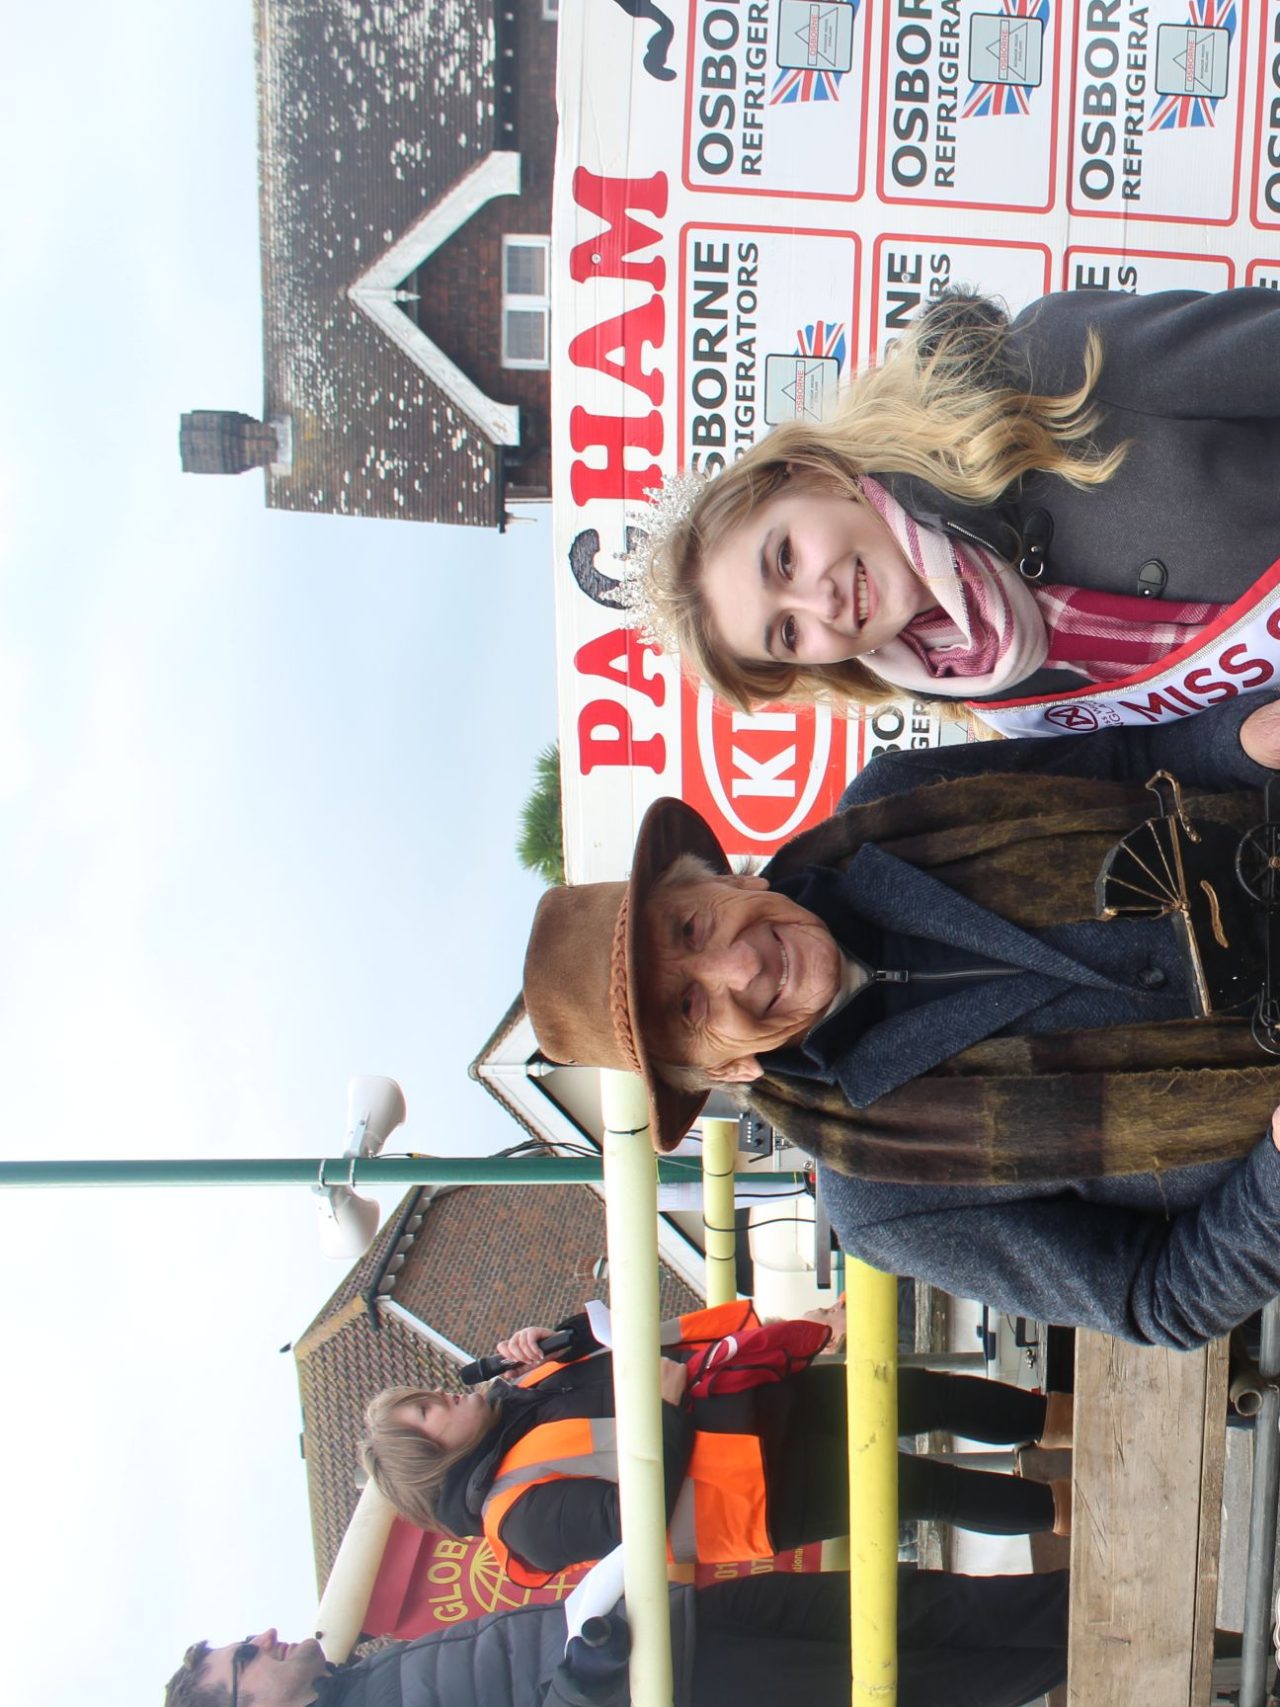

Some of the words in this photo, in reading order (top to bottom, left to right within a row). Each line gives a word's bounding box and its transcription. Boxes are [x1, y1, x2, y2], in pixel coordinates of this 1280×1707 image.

[809, 13, 818, 56] OSBORNE
[1000, 29, 1008, 70] OSBORNE
[1186, 39, 1195, 82] OSBORNE
[697, 0, 740, 175] OSBO
[741, 0, 769, 176] REFRIGER
[691, 242, 729, 478] SBORNE
[733, 242, 758, 462] IGERATORS
[796, 369, 804, 412] OSBORNE
[568, 166, 668, 775] PAGHAM
[1117, 643, 1275, 722] MISS
[731, 710, 796, 798] KI
[427, 1536, 473, 1622] GLOB
